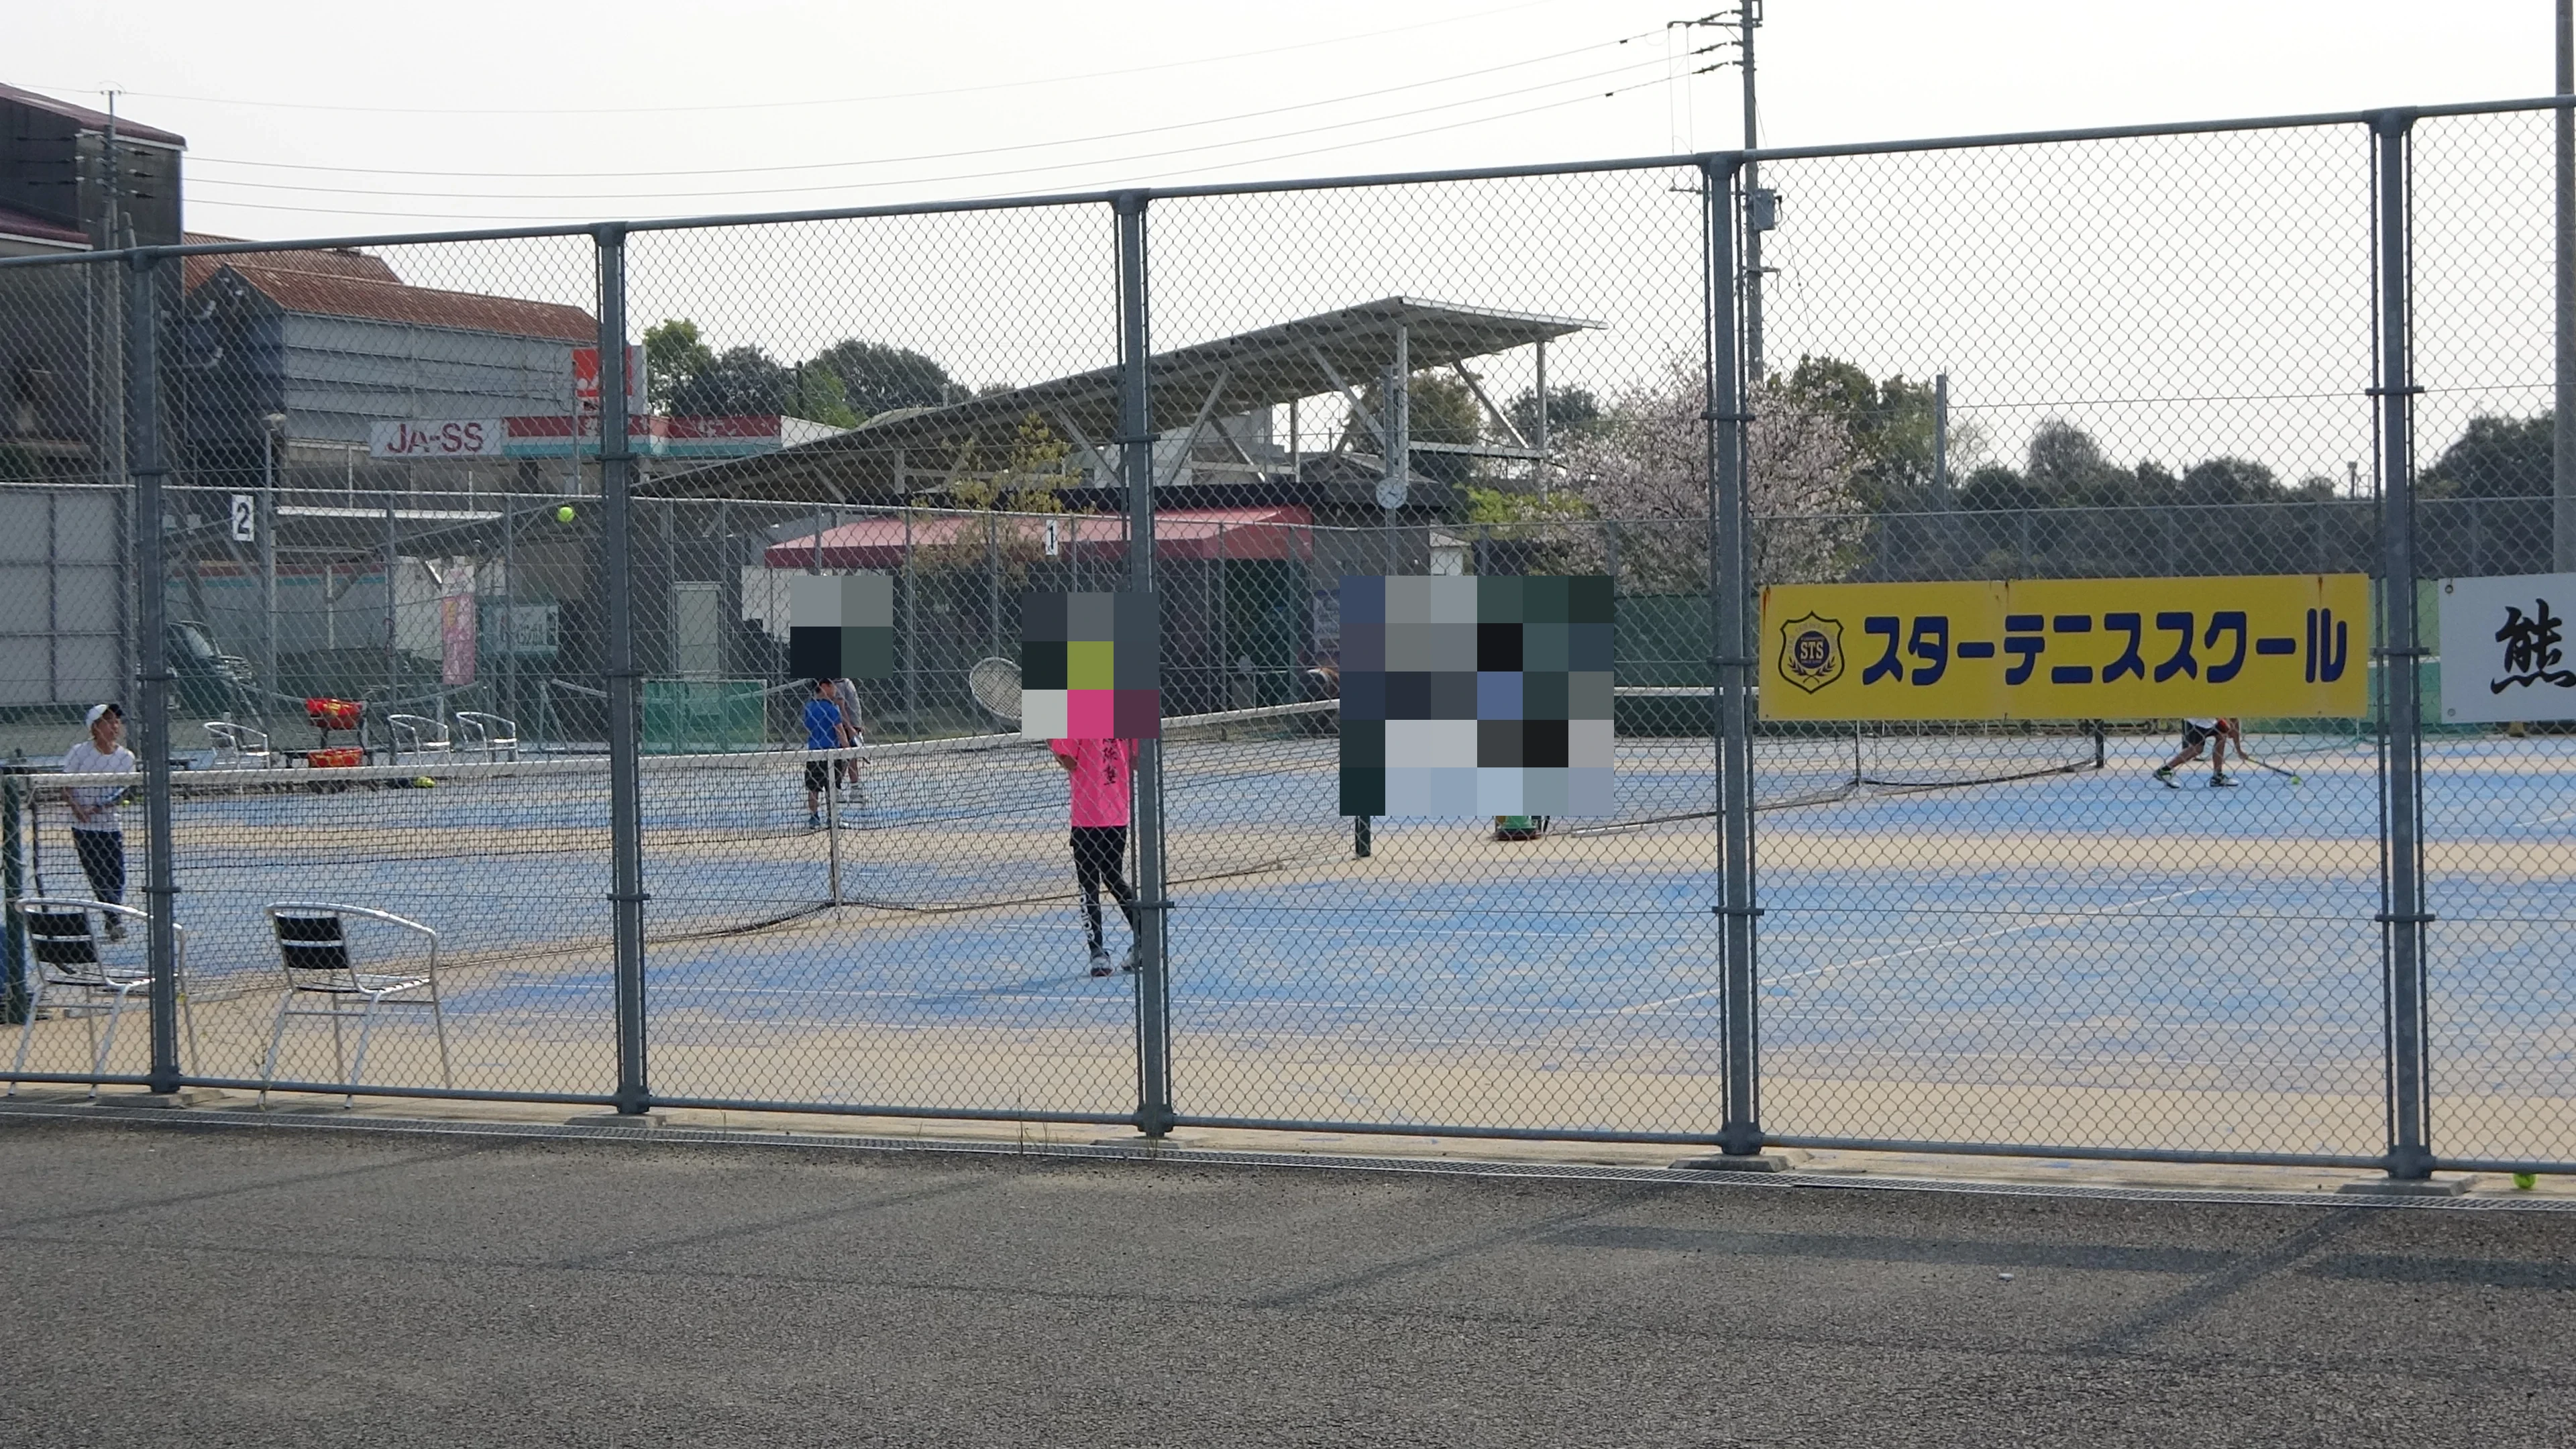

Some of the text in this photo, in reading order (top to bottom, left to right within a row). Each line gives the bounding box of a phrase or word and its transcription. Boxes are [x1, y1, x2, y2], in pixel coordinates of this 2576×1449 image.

[386, 422, 484, 453] JA-SS
[237, 502, 250, 533] 2
[1800, 641, 1824, 660] STS
[1862, 607, 2348, 686] スターテニススクール
[2490, 598, 2576, 695] 熊
